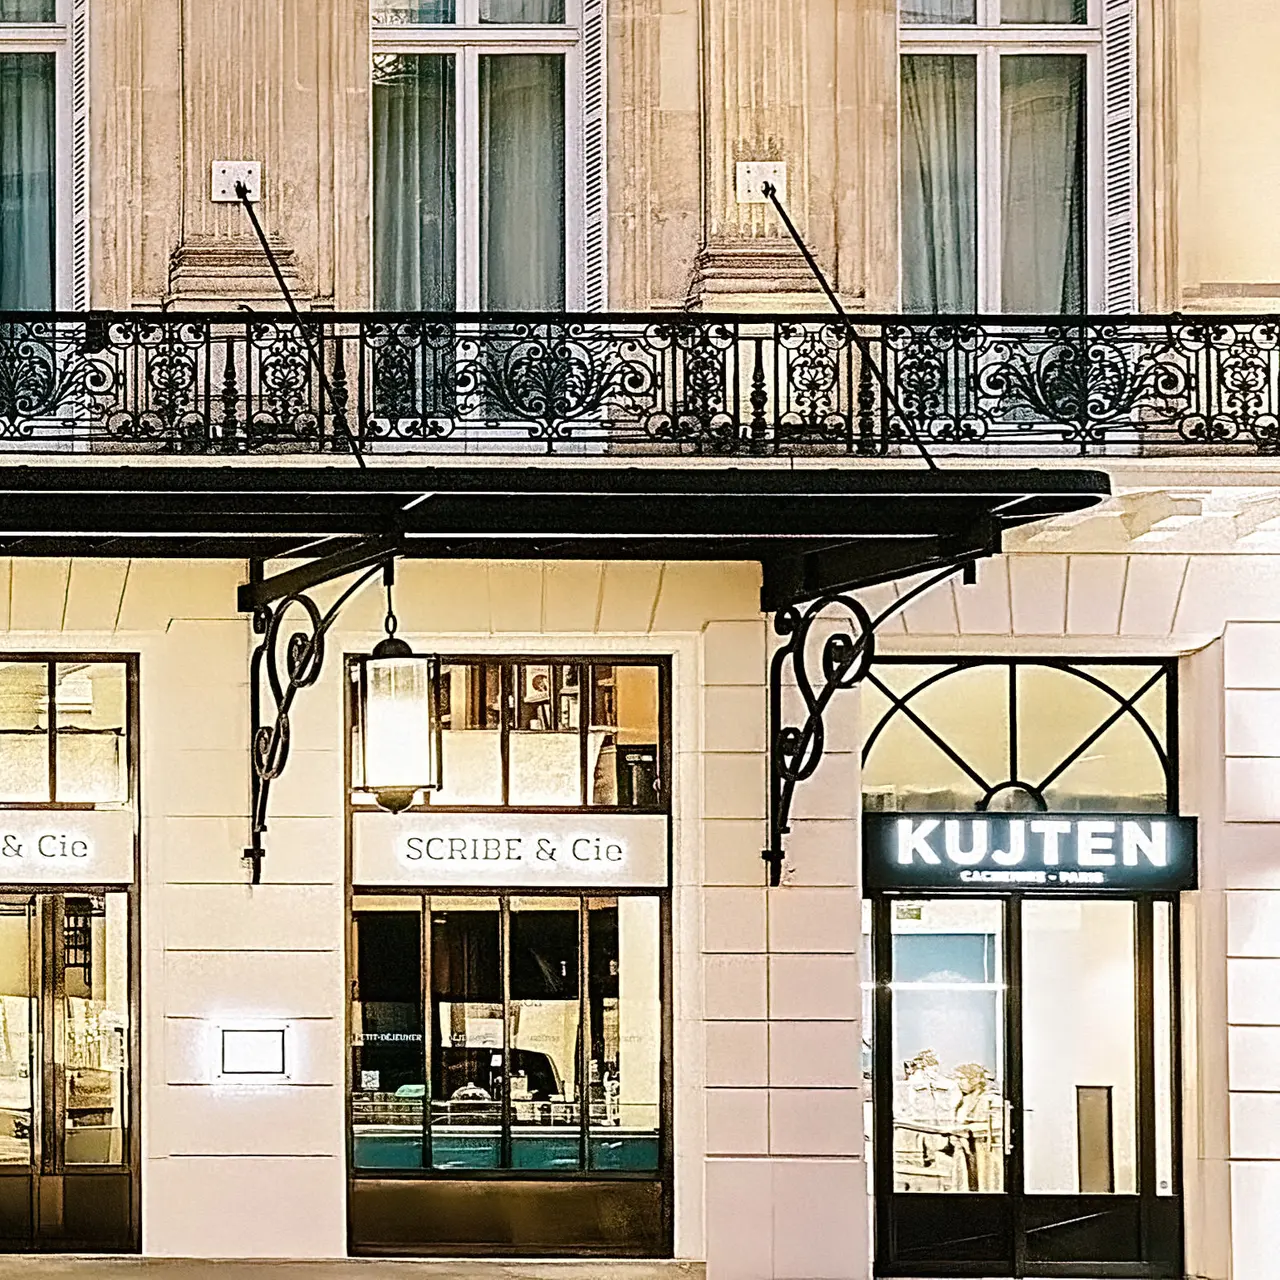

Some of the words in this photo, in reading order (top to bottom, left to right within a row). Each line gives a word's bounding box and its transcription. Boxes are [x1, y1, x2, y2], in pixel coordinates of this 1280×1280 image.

[1, 834, 24, 858] &
[37, 834, 89, 858] Cie
[405, 837, 523, 861] SCRIBE
[535, 838, 558, 862] &
[571, 837, 623, 862] Cie
[896, 818, 1167, 867] KUJTEN
